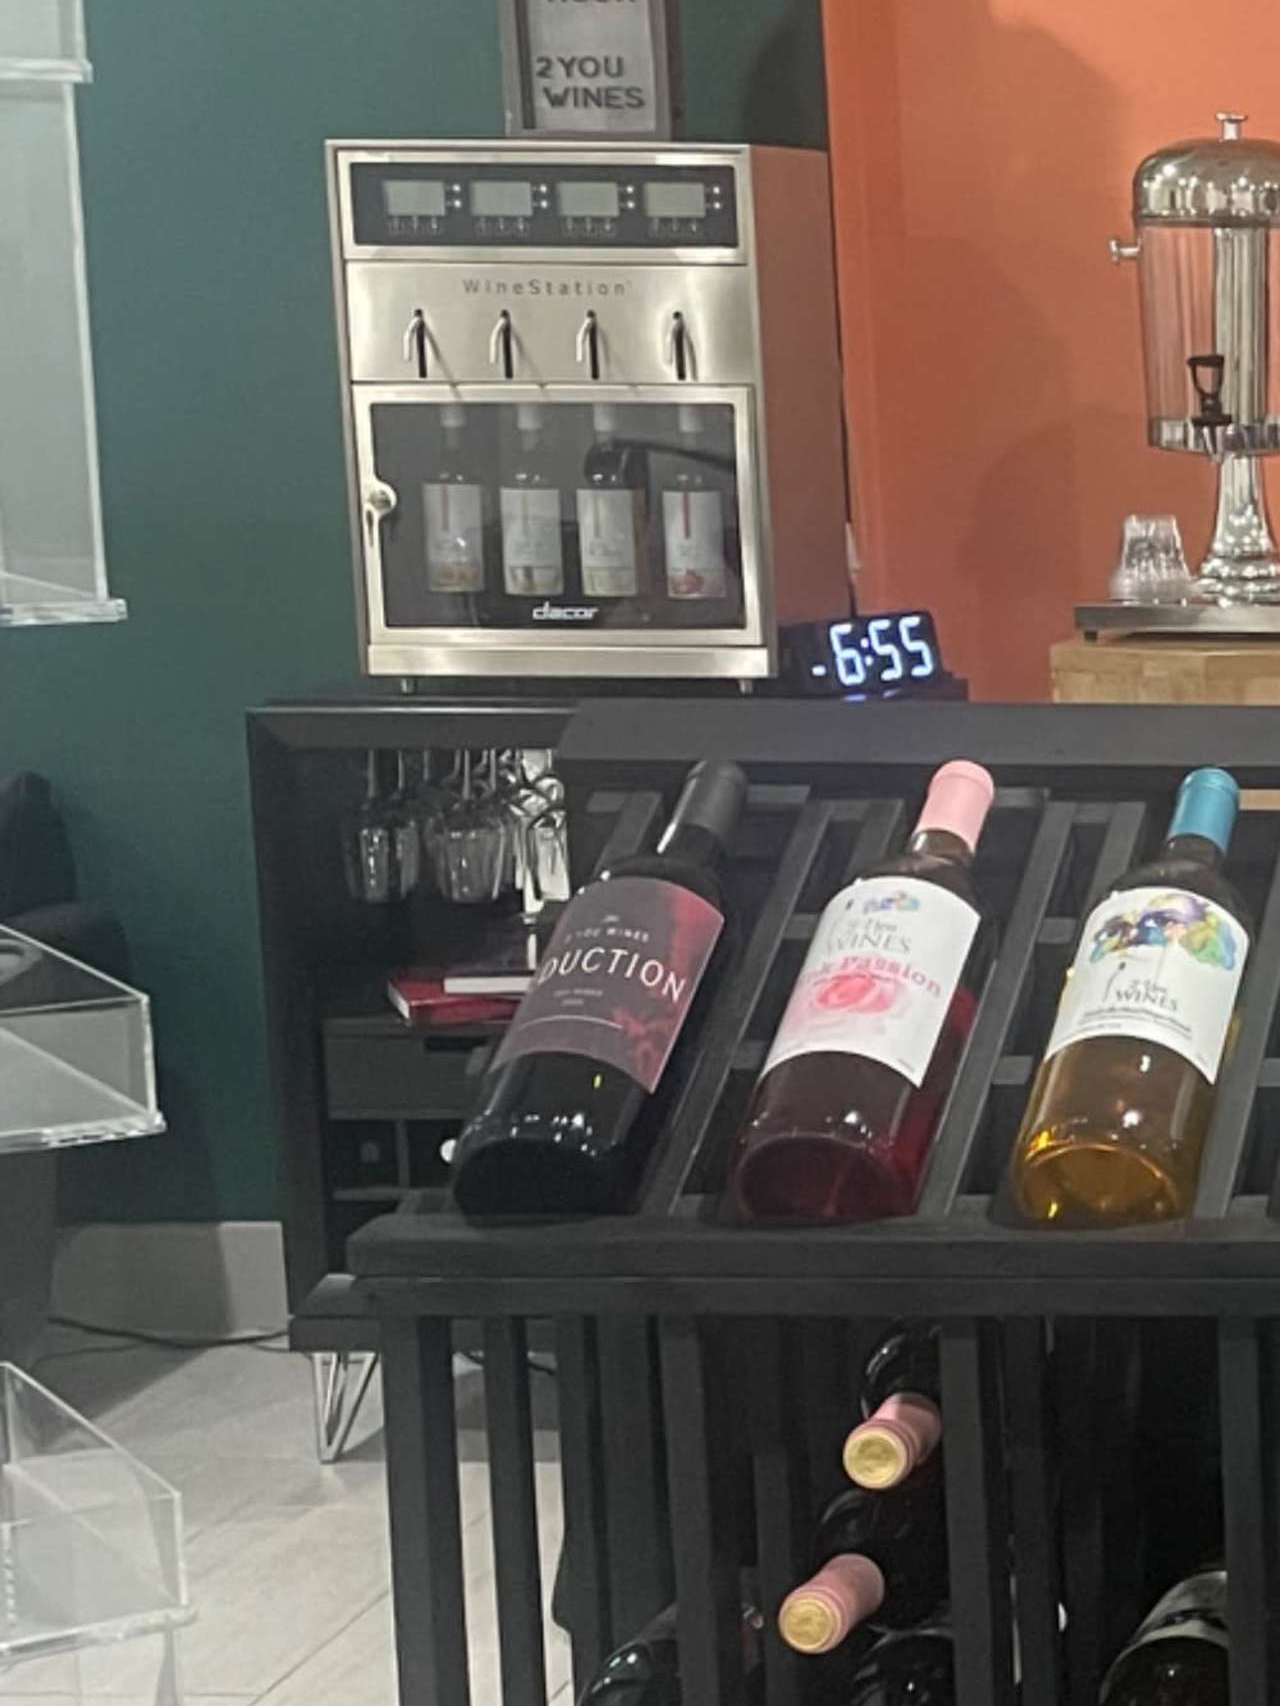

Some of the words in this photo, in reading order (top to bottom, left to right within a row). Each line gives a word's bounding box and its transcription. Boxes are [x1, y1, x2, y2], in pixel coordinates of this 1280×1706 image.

[542, 86, 646, 110] WINES
[531, 600, 600, 621] dacor
[829, 616, 934, 686] 6:55
[537, 946, 686, 1002] DUCTION
